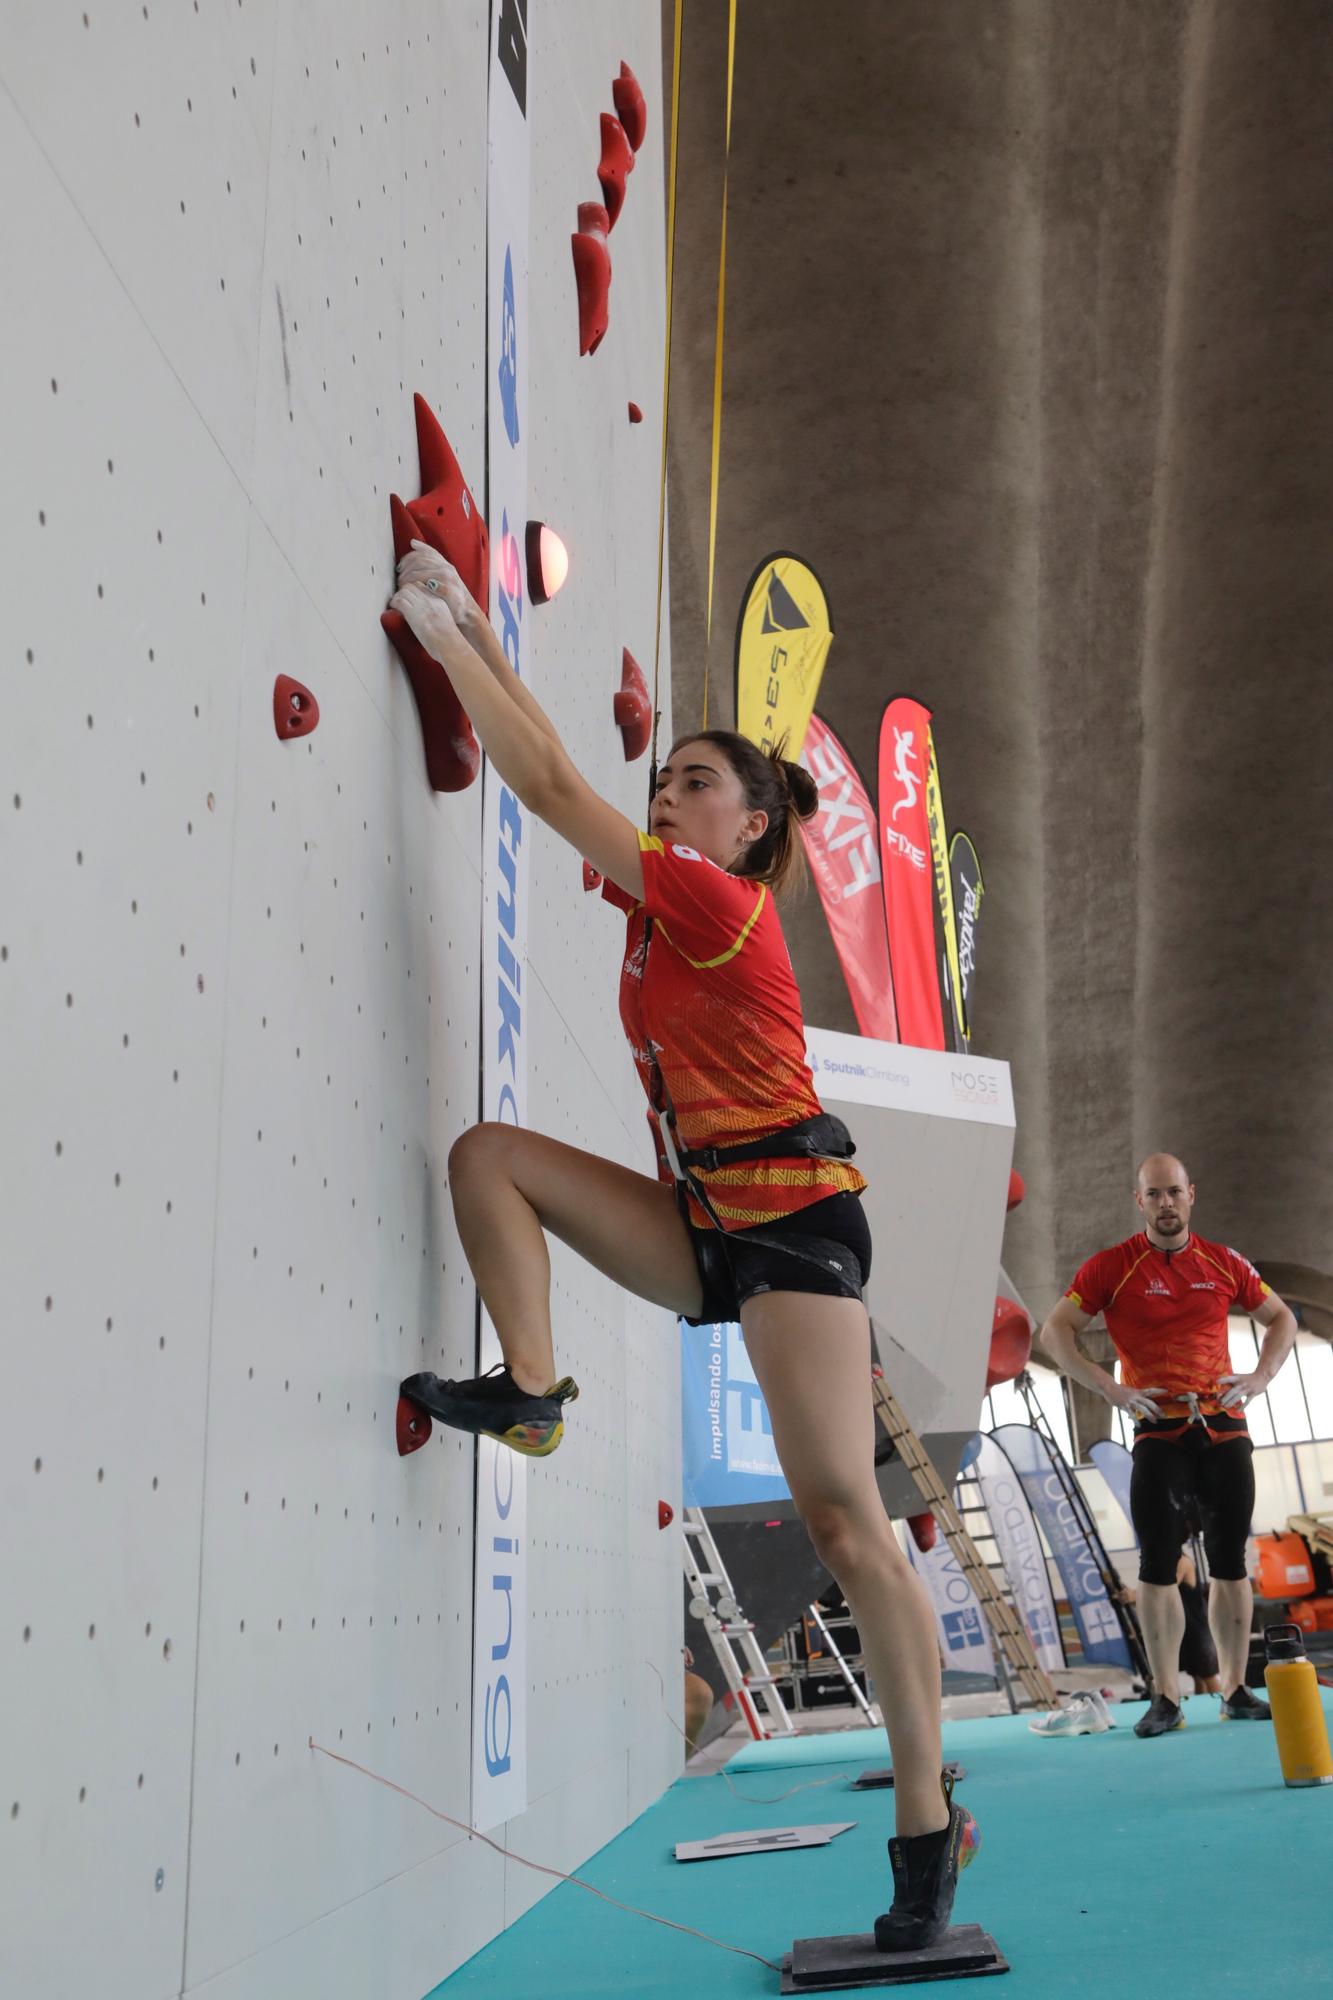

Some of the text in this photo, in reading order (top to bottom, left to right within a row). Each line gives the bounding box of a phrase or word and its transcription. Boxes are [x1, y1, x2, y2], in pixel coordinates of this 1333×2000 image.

[952, 1071, 999, 1094] NOSE
[708, 1323, 723, 1460] impulsando los
